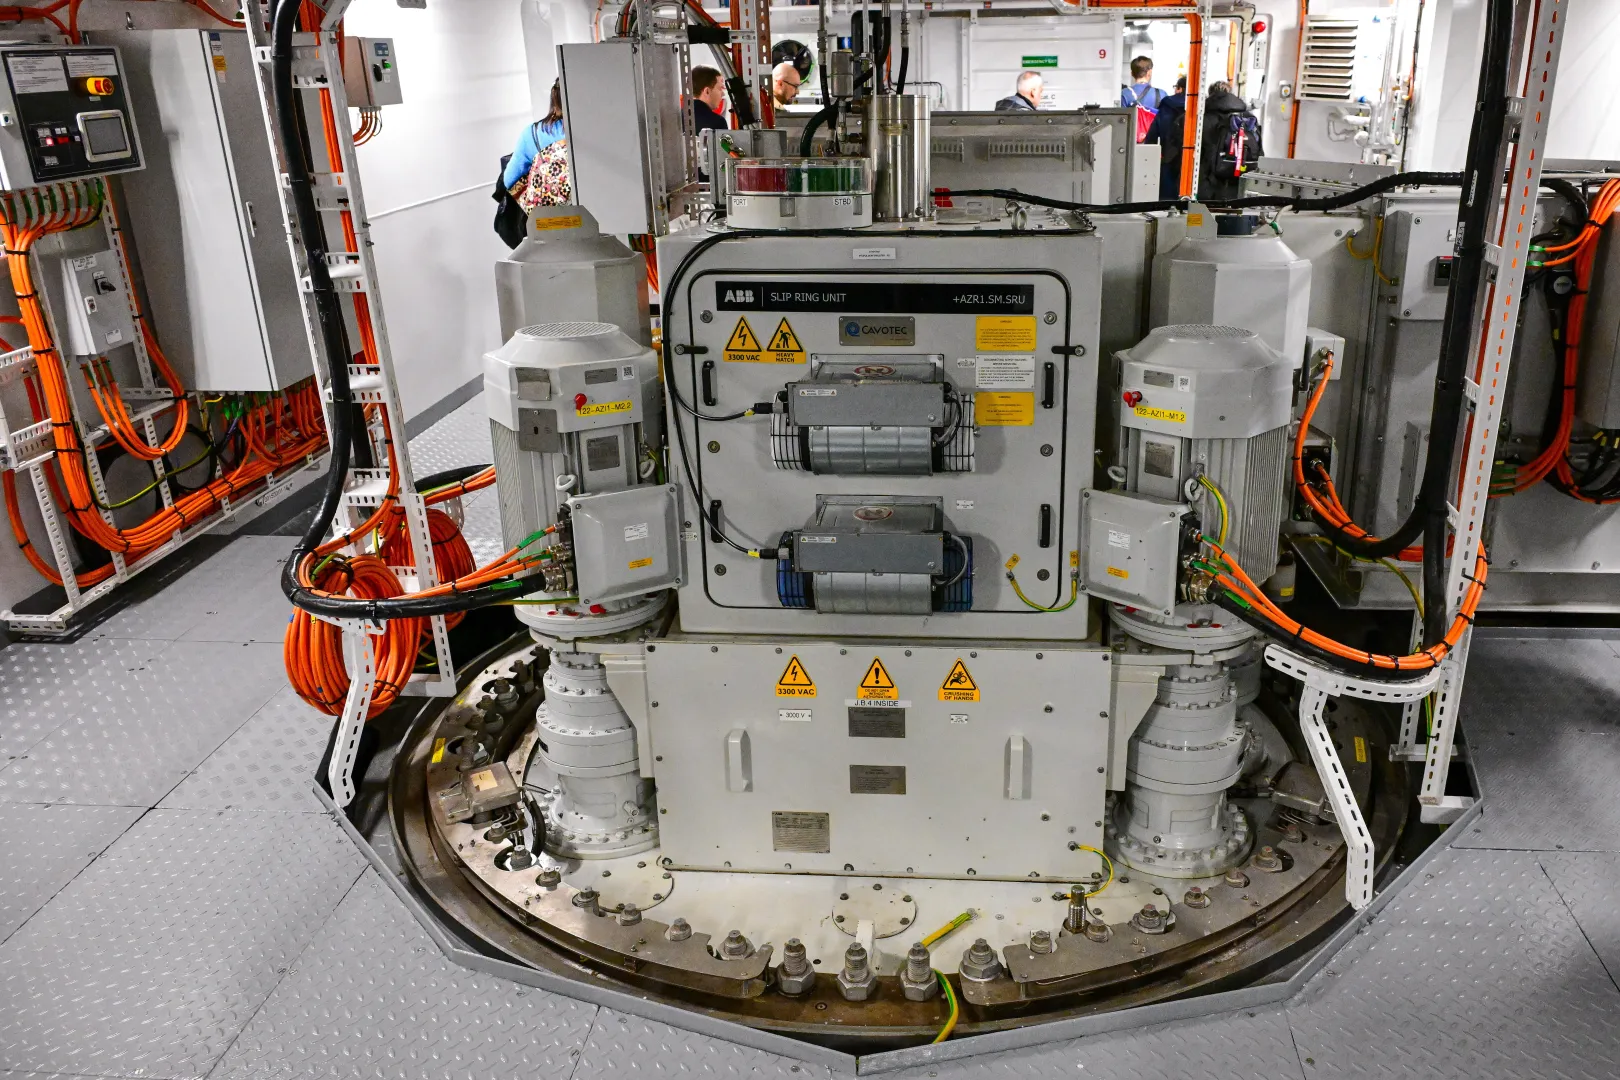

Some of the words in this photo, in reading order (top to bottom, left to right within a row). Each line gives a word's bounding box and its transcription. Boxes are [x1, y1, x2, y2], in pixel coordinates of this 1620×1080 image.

[1099, 49, 1106, 59] 9
[834, 198, 852, 206] STBD
[724, 289, 755, 303] ABB
[770, 292, 792, 302] SLIP
[794, 293, 819, 302] RING
[822, 293, 847, 303] UNIT
[952, 294, 1026, 304] +AZR1.SM.SRU
[861, 325, 907, 335] CAVOTEC
[728, 353, 745, 361] 3300
[797, 688, 815, 696] VAC
